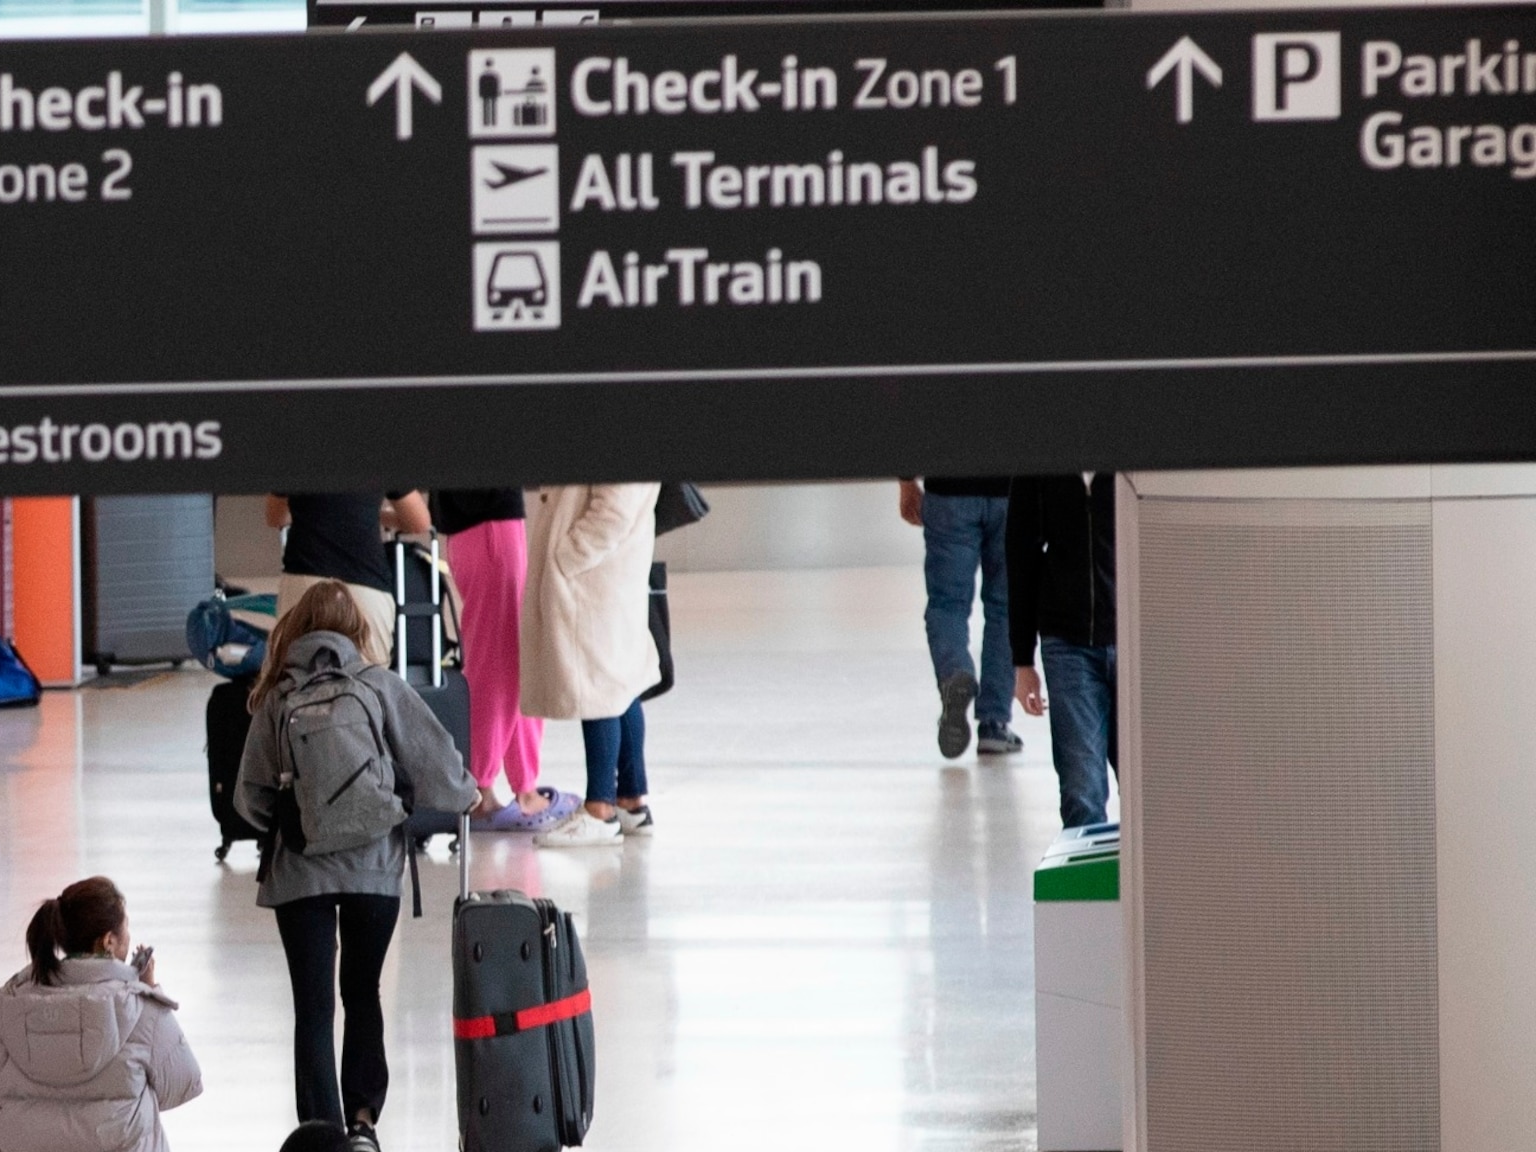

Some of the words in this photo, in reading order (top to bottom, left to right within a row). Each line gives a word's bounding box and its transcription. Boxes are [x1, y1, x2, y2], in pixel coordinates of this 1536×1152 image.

[569, 54, 838, 116] Check-in
[854, 57, 983, 109] Zone
[994, 55, 1017, 106] 1
[99, 148, 133, 200] 2
[1360, 110, 1536, 179] Garag
[569, 152, 661, 212] All
[671, 145, 979, 209] Terminals
[577, 247, 823, 308] AirTrain
